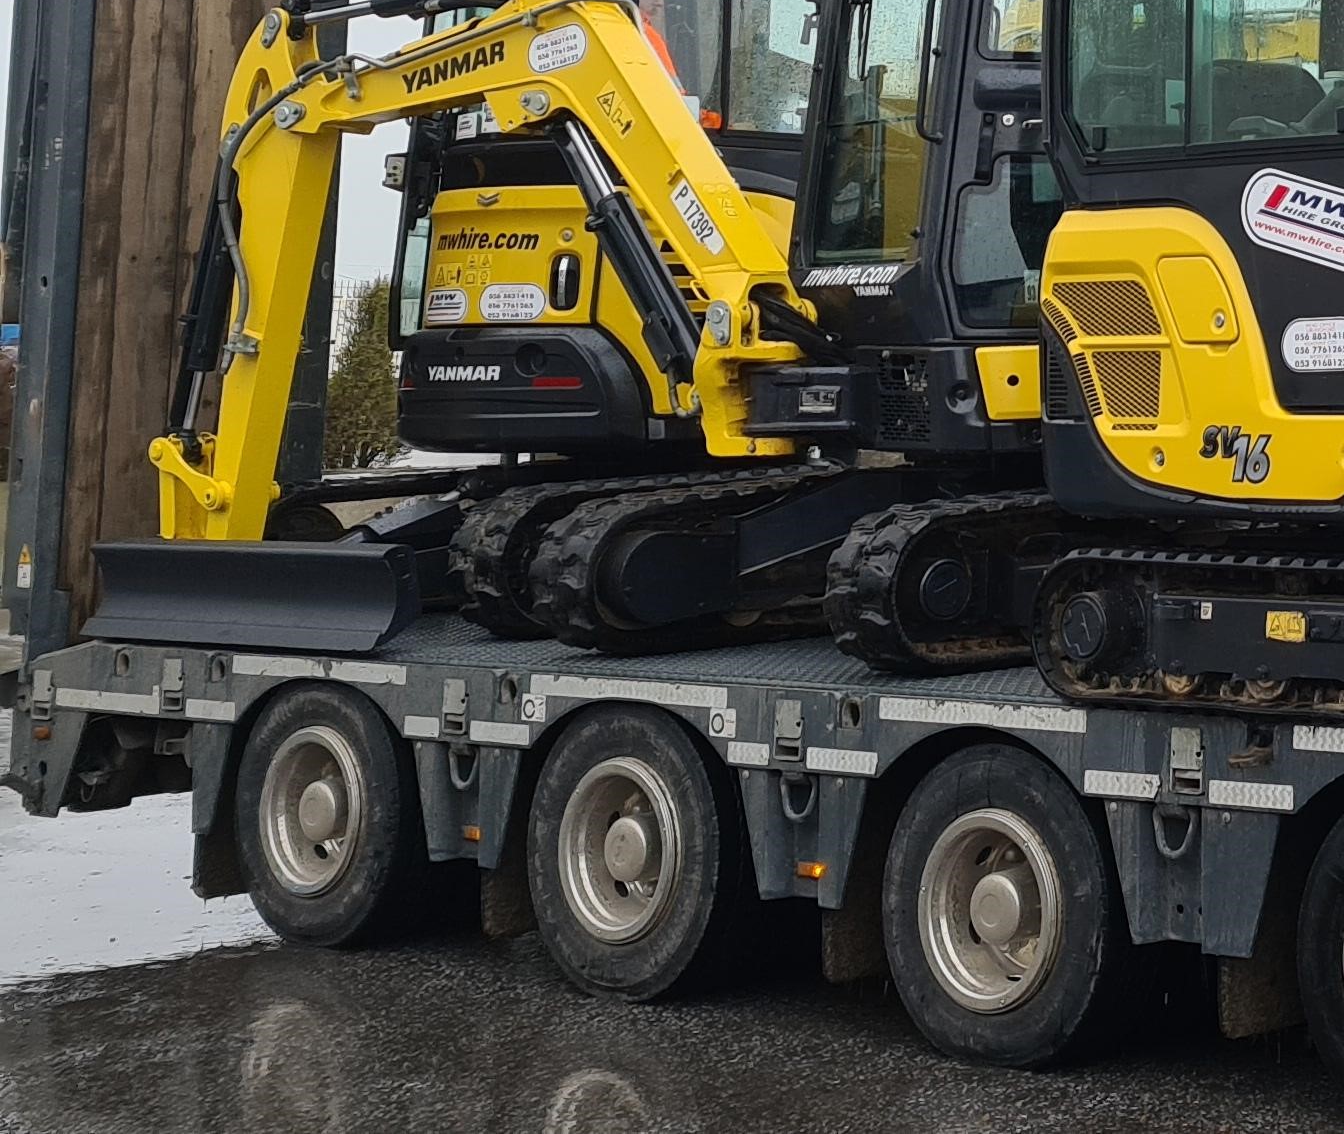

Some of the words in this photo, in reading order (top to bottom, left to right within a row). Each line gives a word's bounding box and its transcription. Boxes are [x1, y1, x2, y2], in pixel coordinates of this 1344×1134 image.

[401, 40, 505, 94] YANMAR
[674, 184, 689, 201] P
[683, 199, 714, 244] 17392
[1281, 206, 1317, 222] HIRE
[436, 226, 540, 251] mwhire.com
[801, 264, 899, 286] mwhire.com
[427, 366, 501, 381] YANMAR
